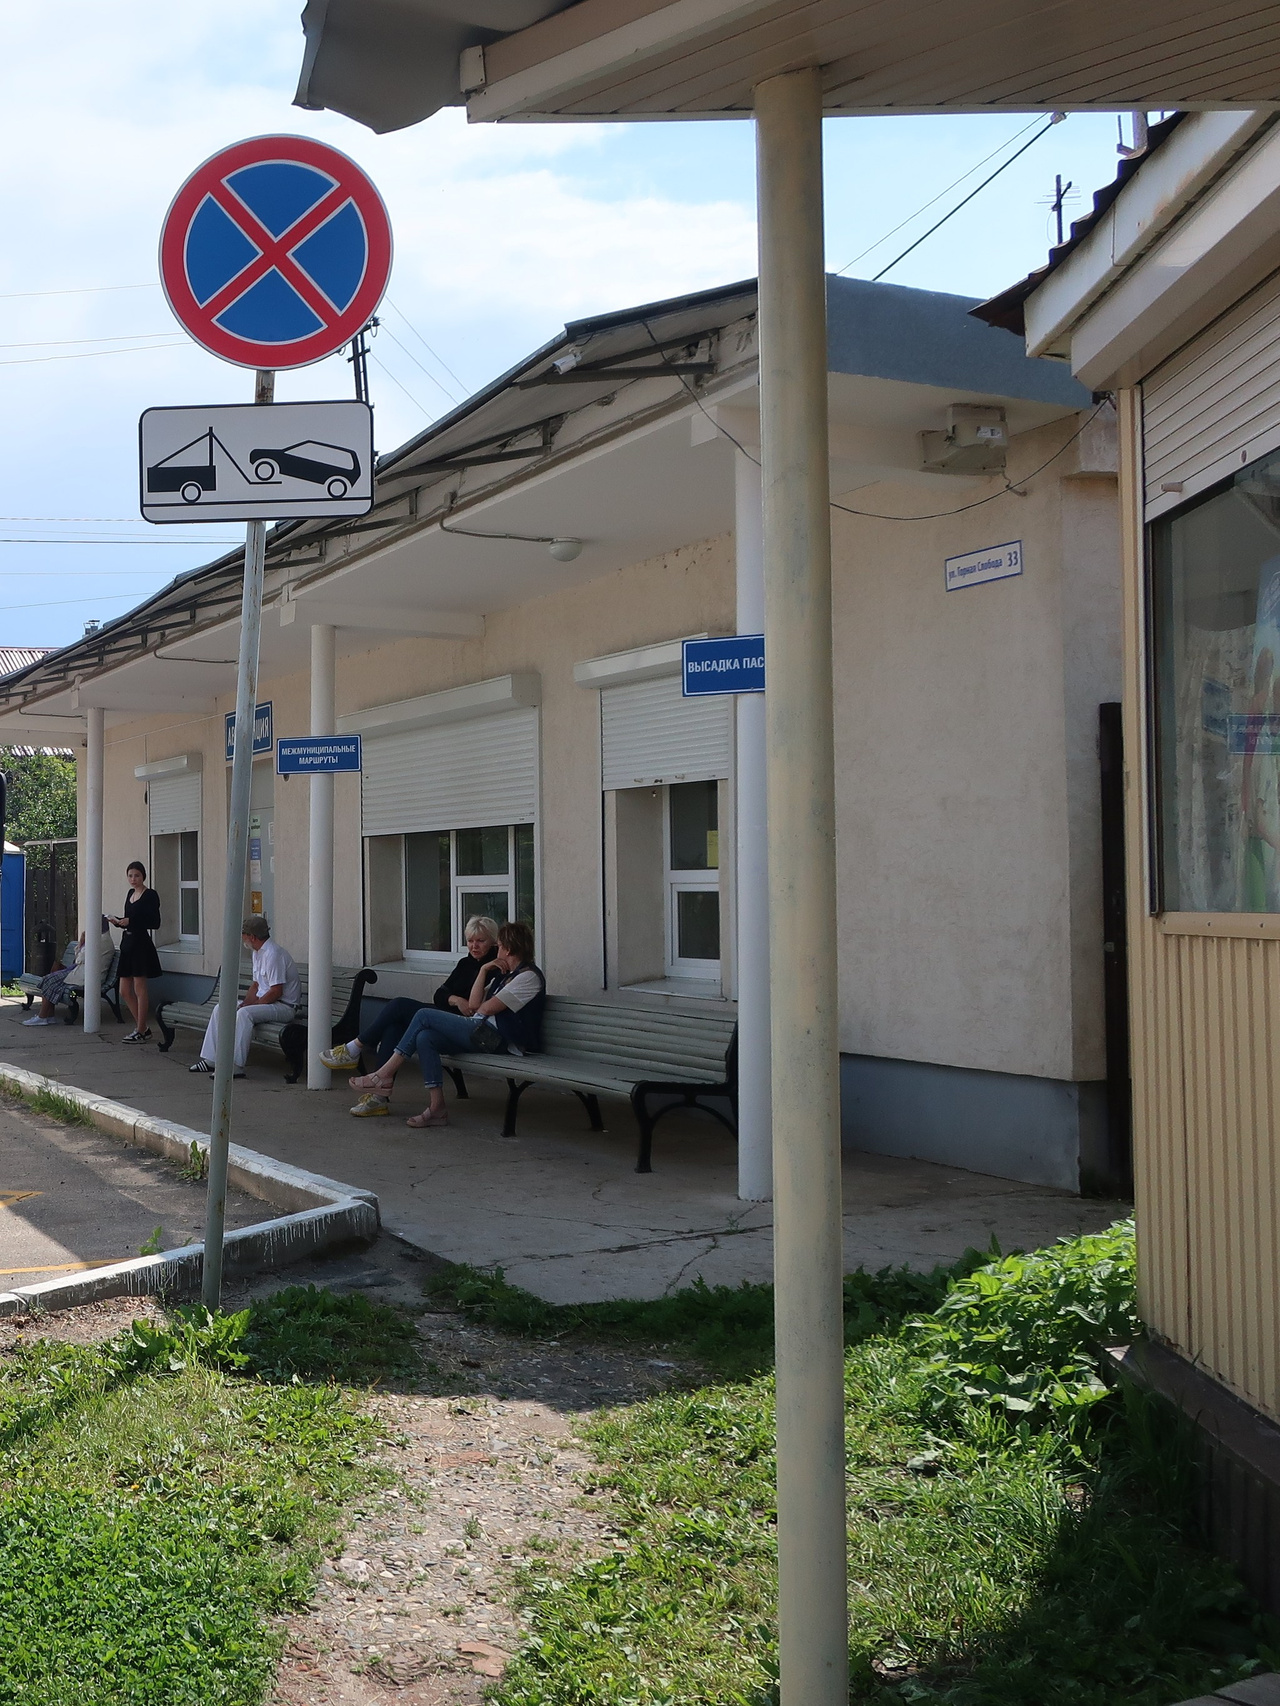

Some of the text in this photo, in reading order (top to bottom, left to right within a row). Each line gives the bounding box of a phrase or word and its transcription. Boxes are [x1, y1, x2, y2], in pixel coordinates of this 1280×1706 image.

[957, 565, 976, 578] Горная
[978, 558, 1002, 572] Слобода
[1007, 550, 1018, 567] 33
[688, 656, 765, 673] ВЫСАДКА ПАС
[281, 744, 356, 756] МЕЖМУНИЦИПАЛЬНЫЕ
[298, 755, 338, 765] МАРШРУТЫ
